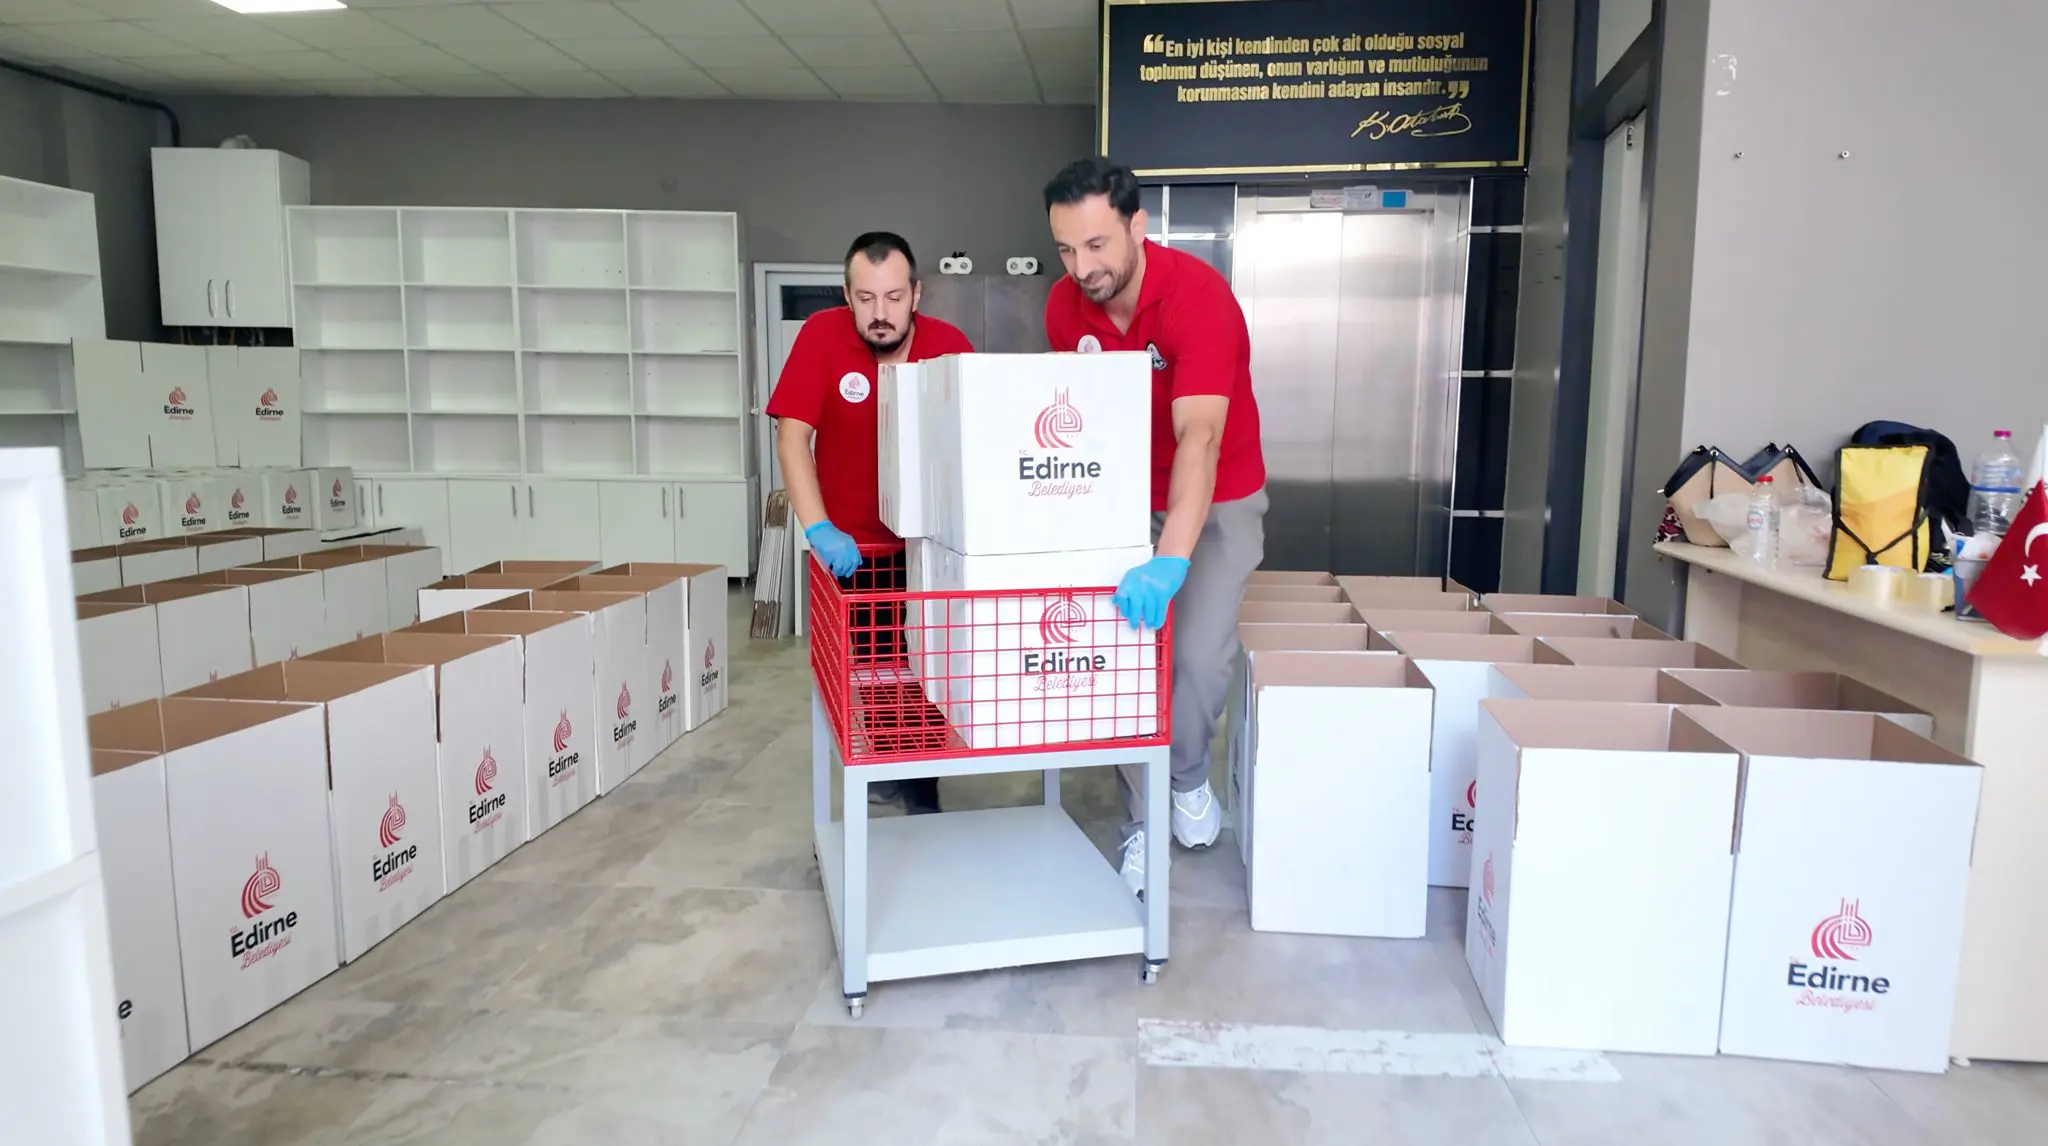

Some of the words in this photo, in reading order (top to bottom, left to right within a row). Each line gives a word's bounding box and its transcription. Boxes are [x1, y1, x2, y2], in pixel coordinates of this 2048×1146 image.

[1187, 38, 1204, 59] iyi
[1207, 37, 1233, 59] kişi
[1235, 35, 1309, 55] kendinden
[1313, 35, 1340, 56] çok
[1342, 33, 1362, 52] ait
[1365, 32, 1414, 52] olduğu
[1417, 31, 1464, 51] sosyal
[1140, 63, 1197, 82] toplumu
[1200, 60, 1264, 81] düşünen,
[1267, 61, 1302, 77] onun
[1306, 56, 1364, 76] varlığını
[1368, 58, 1385, 74] ve
[1388, 54, 1489, 74] mutluluğunun
[1177, 84, 1270, 102] korunmasına
[1272, 80, 1325, 100] kendini
[1328, 80, 1380, 99] adayan
[163, 405, 194, 415] Edirne
[255, 407, 284, 416] Edirne
[1019, 456, 1102, 480] Edirne
[1028, 480, 1094, 499] Belediyesi
[181, 517, 206, 527] Edirne
[228, 510, 250, 521] Edirne
[119, 526, 147, 538] Edirne
[1024, 651, 1106, 676] Edirne
[659, 694, 677, 713] Edirne
[613, 720, 637, 742] Edirne
[548, 752, 579, 778] Edirne
[469, 793, 506, 824] Edirne
[372, 844, 417, 882] Edirne
[230, 911, 298, 958] Edirne
[1787, 963, 1891, 994] Edirne
